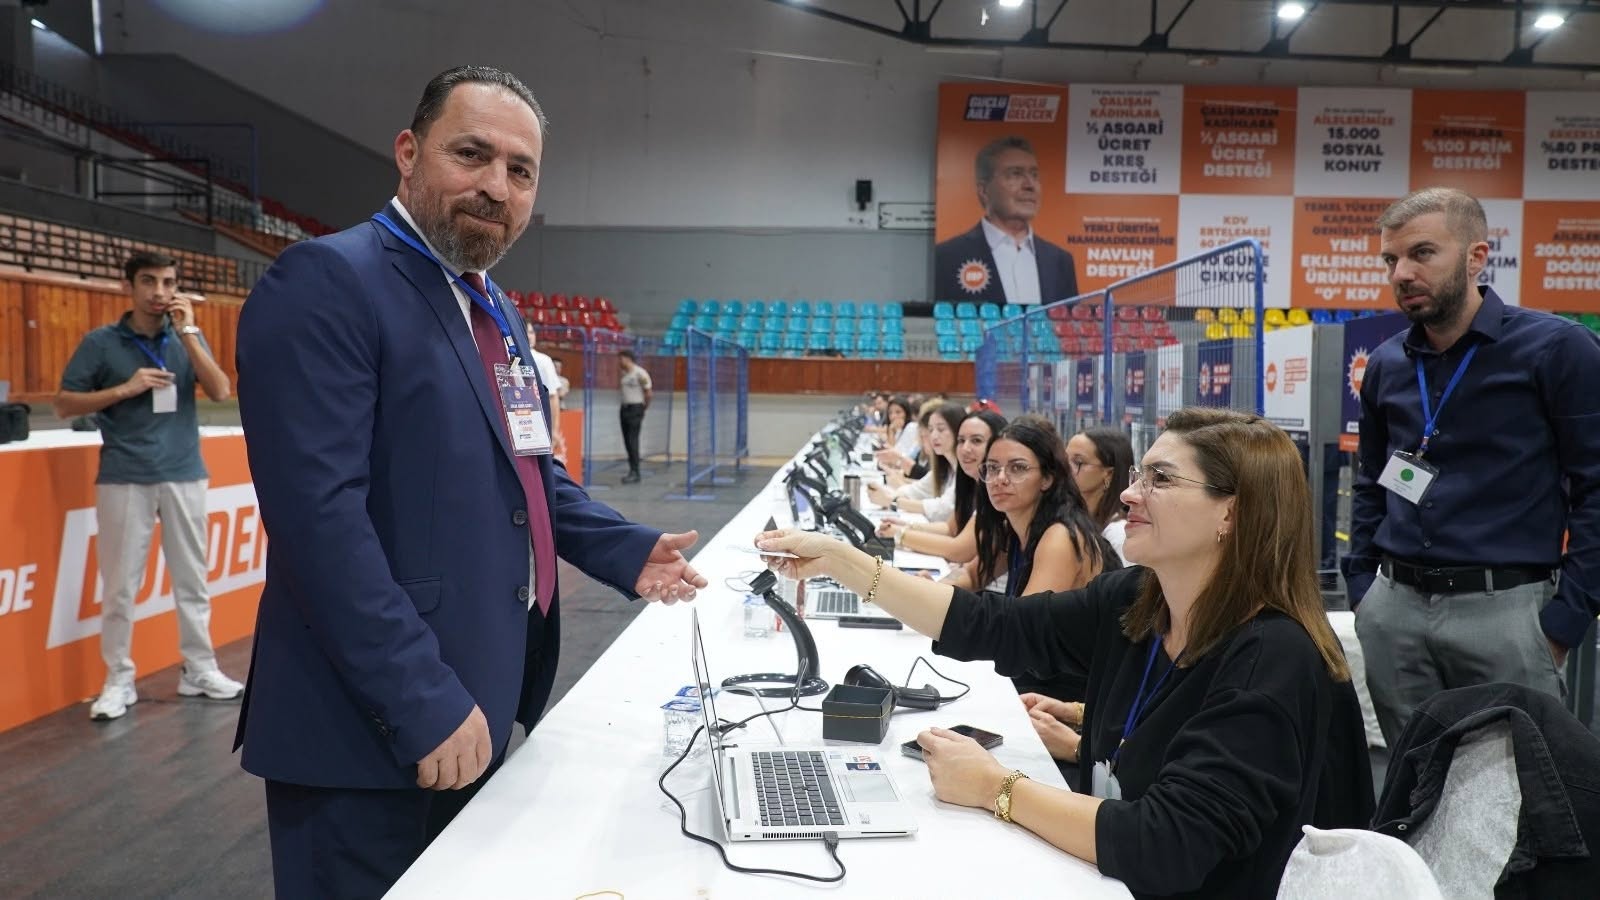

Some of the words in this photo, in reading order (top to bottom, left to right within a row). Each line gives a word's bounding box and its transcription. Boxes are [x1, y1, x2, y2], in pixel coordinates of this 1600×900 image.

[1090, 108, 1161, 118] KADINLARA
[1102, 119, 1164, 135] ASGARİ
[1327, 127, 1380, 140] 15.000
[1098, 135, 1151, 151] ÜCRET
[1215, 128, 1278, 144] ASGARİ
[1211, 144, 1265, 160] ÜCRET
[1322, 143, 1384, 156] SOSYAL
[1469, 138, 1513, 153] PRİM
[1103, 154, 1145, 170] KREŞ
[1324, 160, 1382, 172] KONUT
[1432, 154, 1501, 169] DESTEĞİ
[1547, 158, 1600, 171] DESTE
[1090, 168, 1157, 183] DESTEĞİ
[1203, 161, 1272, 177] DESTEĞİ
[1304, 202, 1341, 212] TEMEL
[1223, 215, 1249, 226] KDV
[1083, 222, 1114, 233] YERLİ
[1117, 222, 1160, 234] ÜRETİM
[1200, 225, 1271, 237] ERTELEMESİ
[1067, 235, 1175, 246] HAMMADDELERİNE
[1330, 235, 1369, 252] YENİ
[1087, 247, 1155, 261] NAVLUN
[1301, 254, 1385, 268] EKLENECE
[1345, 287, 1381, 301] KDV
